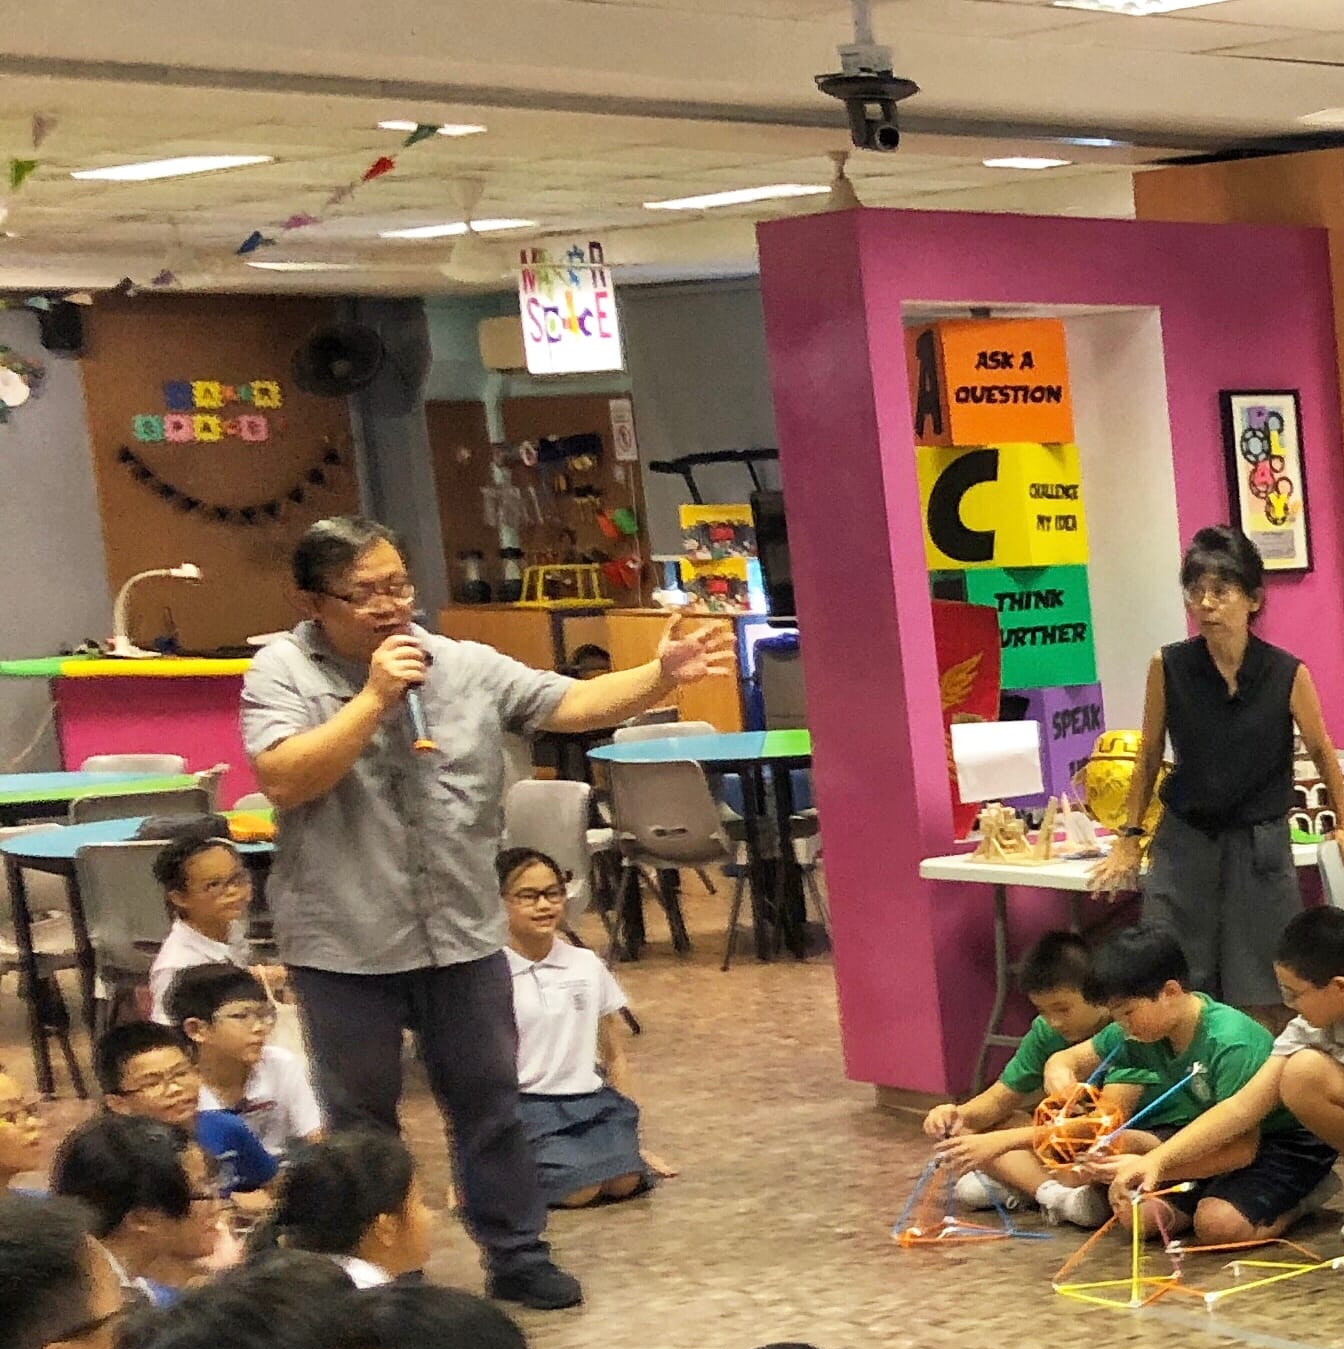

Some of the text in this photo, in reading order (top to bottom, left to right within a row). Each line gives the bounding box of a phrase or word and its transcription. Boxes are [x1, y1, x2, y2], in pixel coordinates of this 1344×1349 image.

[975, 351, 1035, 370] ASK A
[915, 329, 942, 440] A
[955, 385, 1062, 404] QUESTION
[1029, 483, 1079, 500] CHALLENGE
[927, 448, 999, 562] C
[1037, 514, 1077, 531] MY IDEA
[993, 589, 1065, 612] THINK
[1052, 703, 1100, 740] SPEAK
